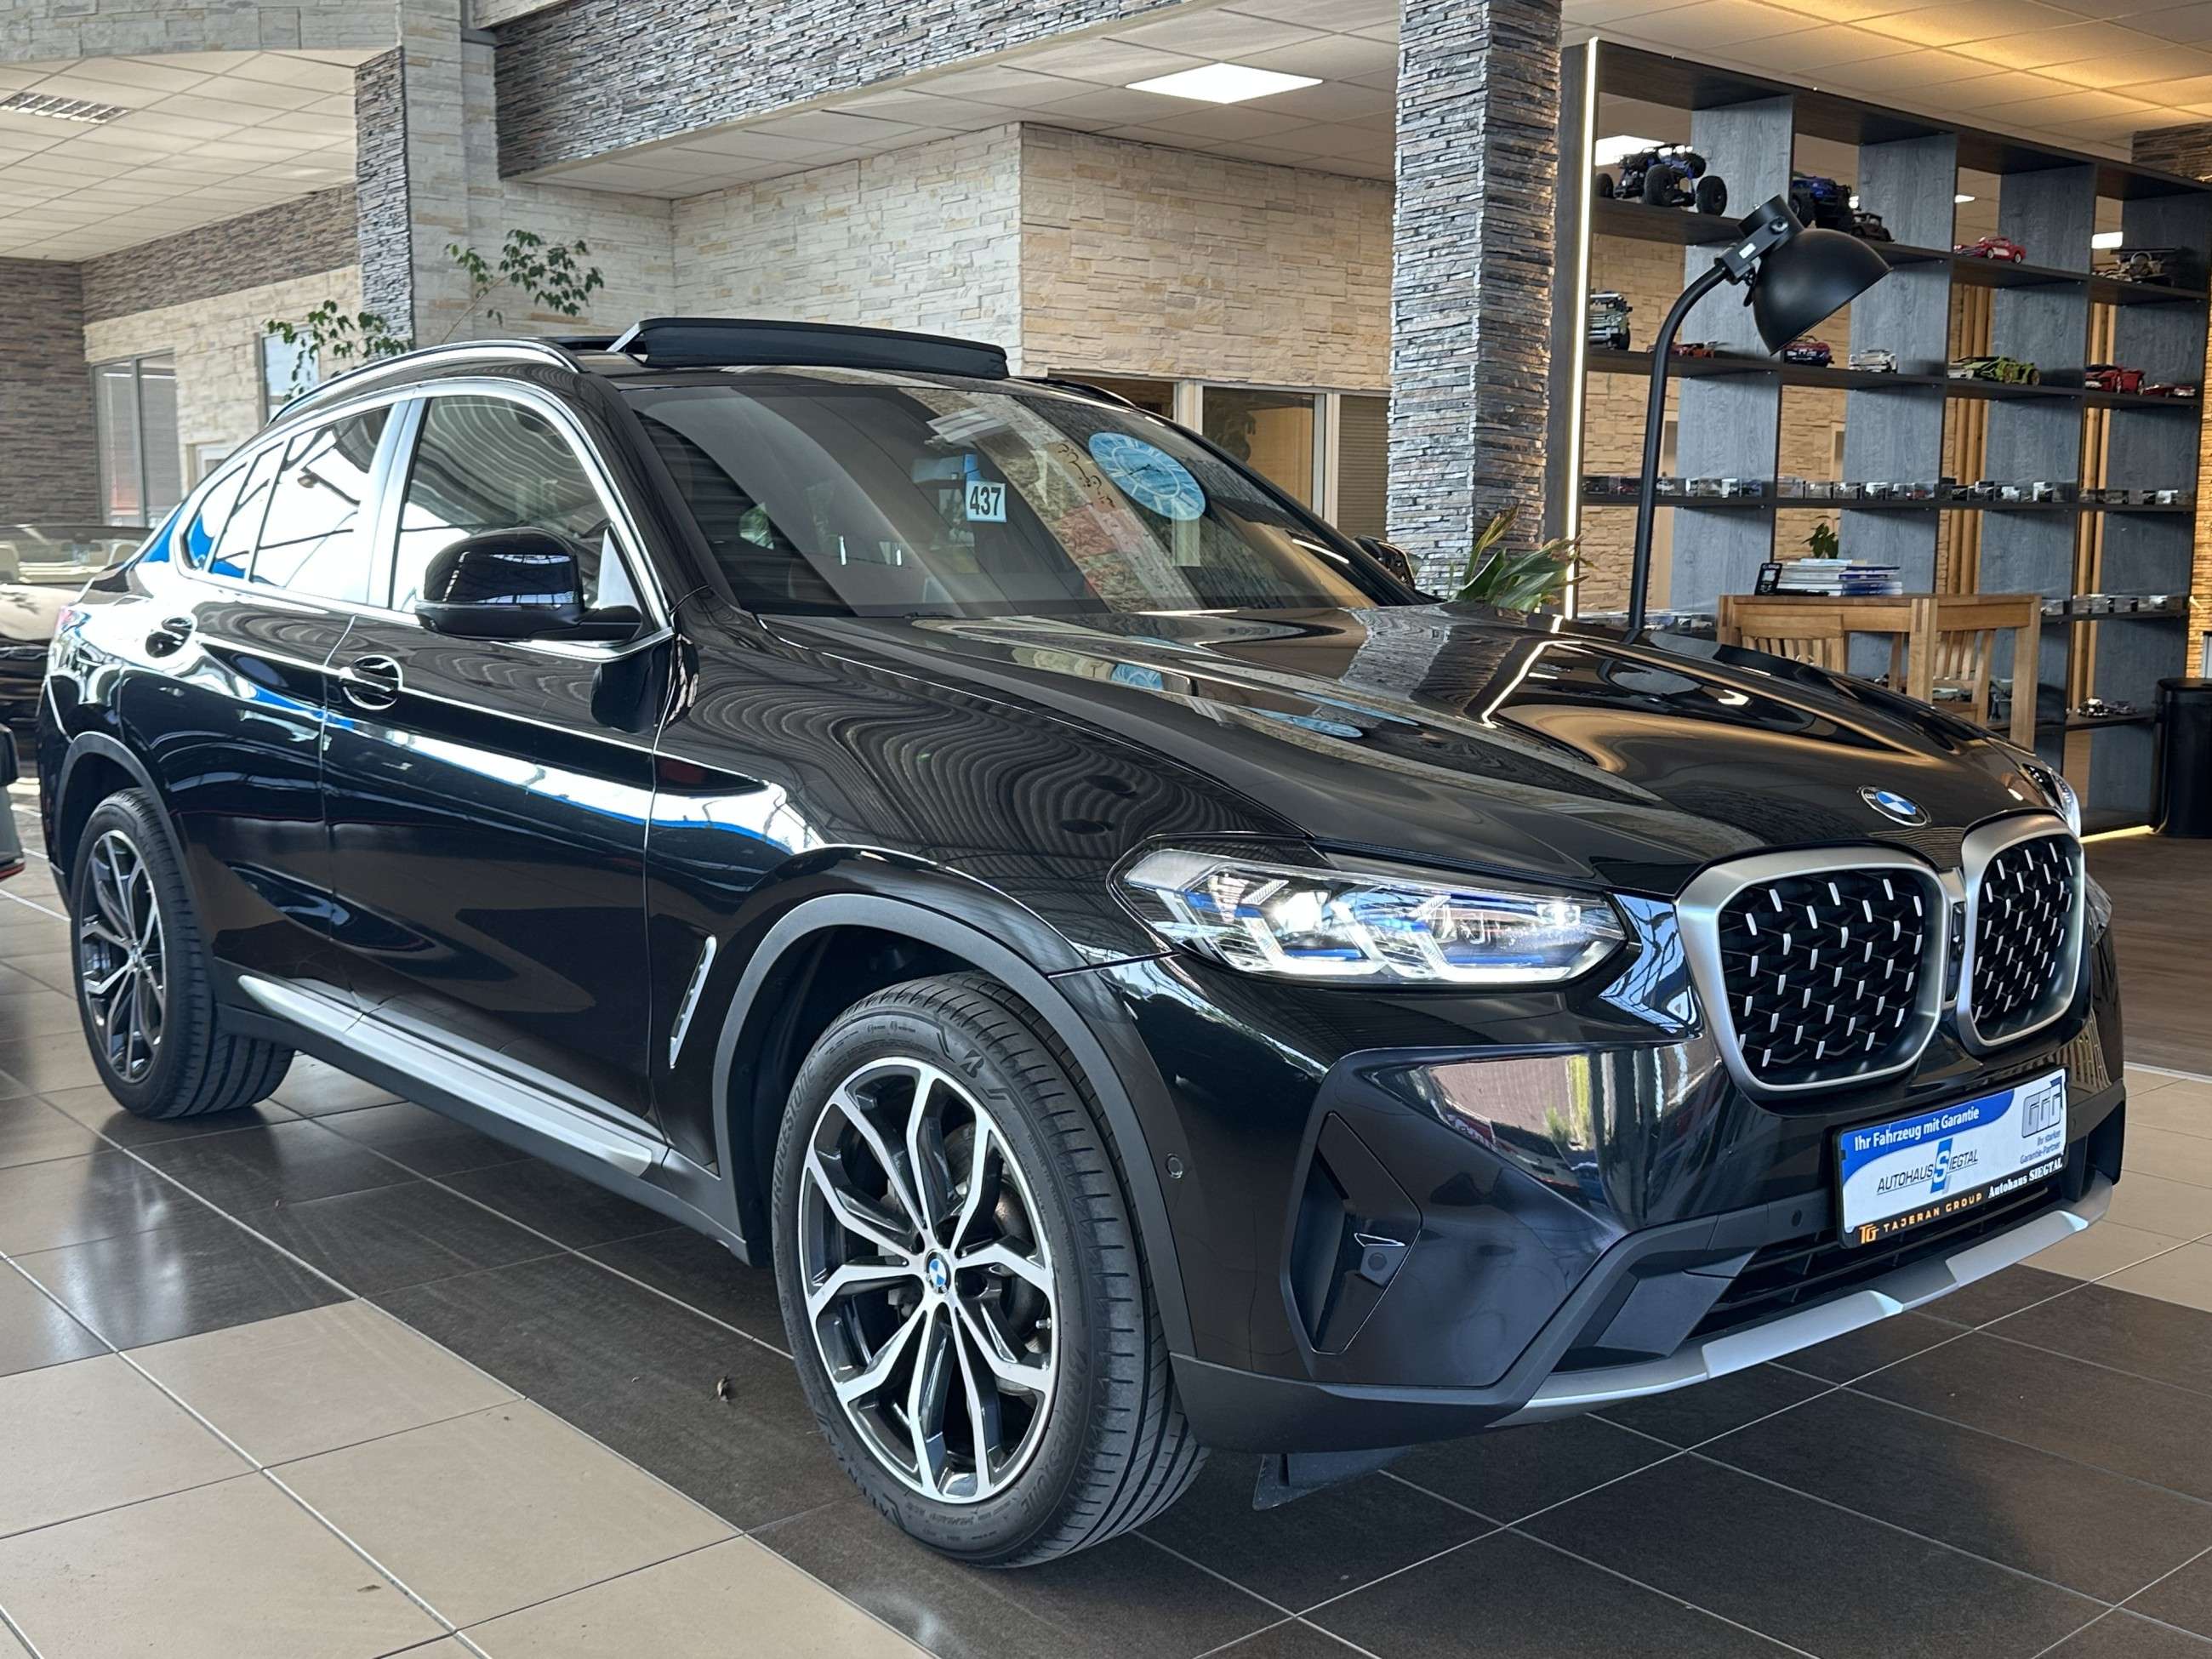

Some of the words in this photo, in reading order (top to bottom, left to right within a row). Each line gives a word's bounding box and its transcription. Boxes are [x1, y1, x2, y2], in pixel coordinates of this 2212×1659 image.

[970, 486, 1001, 516] 437
[1854, 1135, 1872, 1151] Ihr
[1873, 1126, 1922, 1148] Fahrzeug
[1923, 1118, 1941, 1135] mit
[1941, 1106, 1980, 1129] Garantie
[1877, 1163, 1934, 1193] AUTOHAUS
[1883, 1206, 1941, 1233] TAJERAN
[1945, 1192, 1983, 1212] GROUP
[1987, 1173, 2027, 1199] Autohaus
[2028, 1157, 2063, 1181] SIEGTAL
